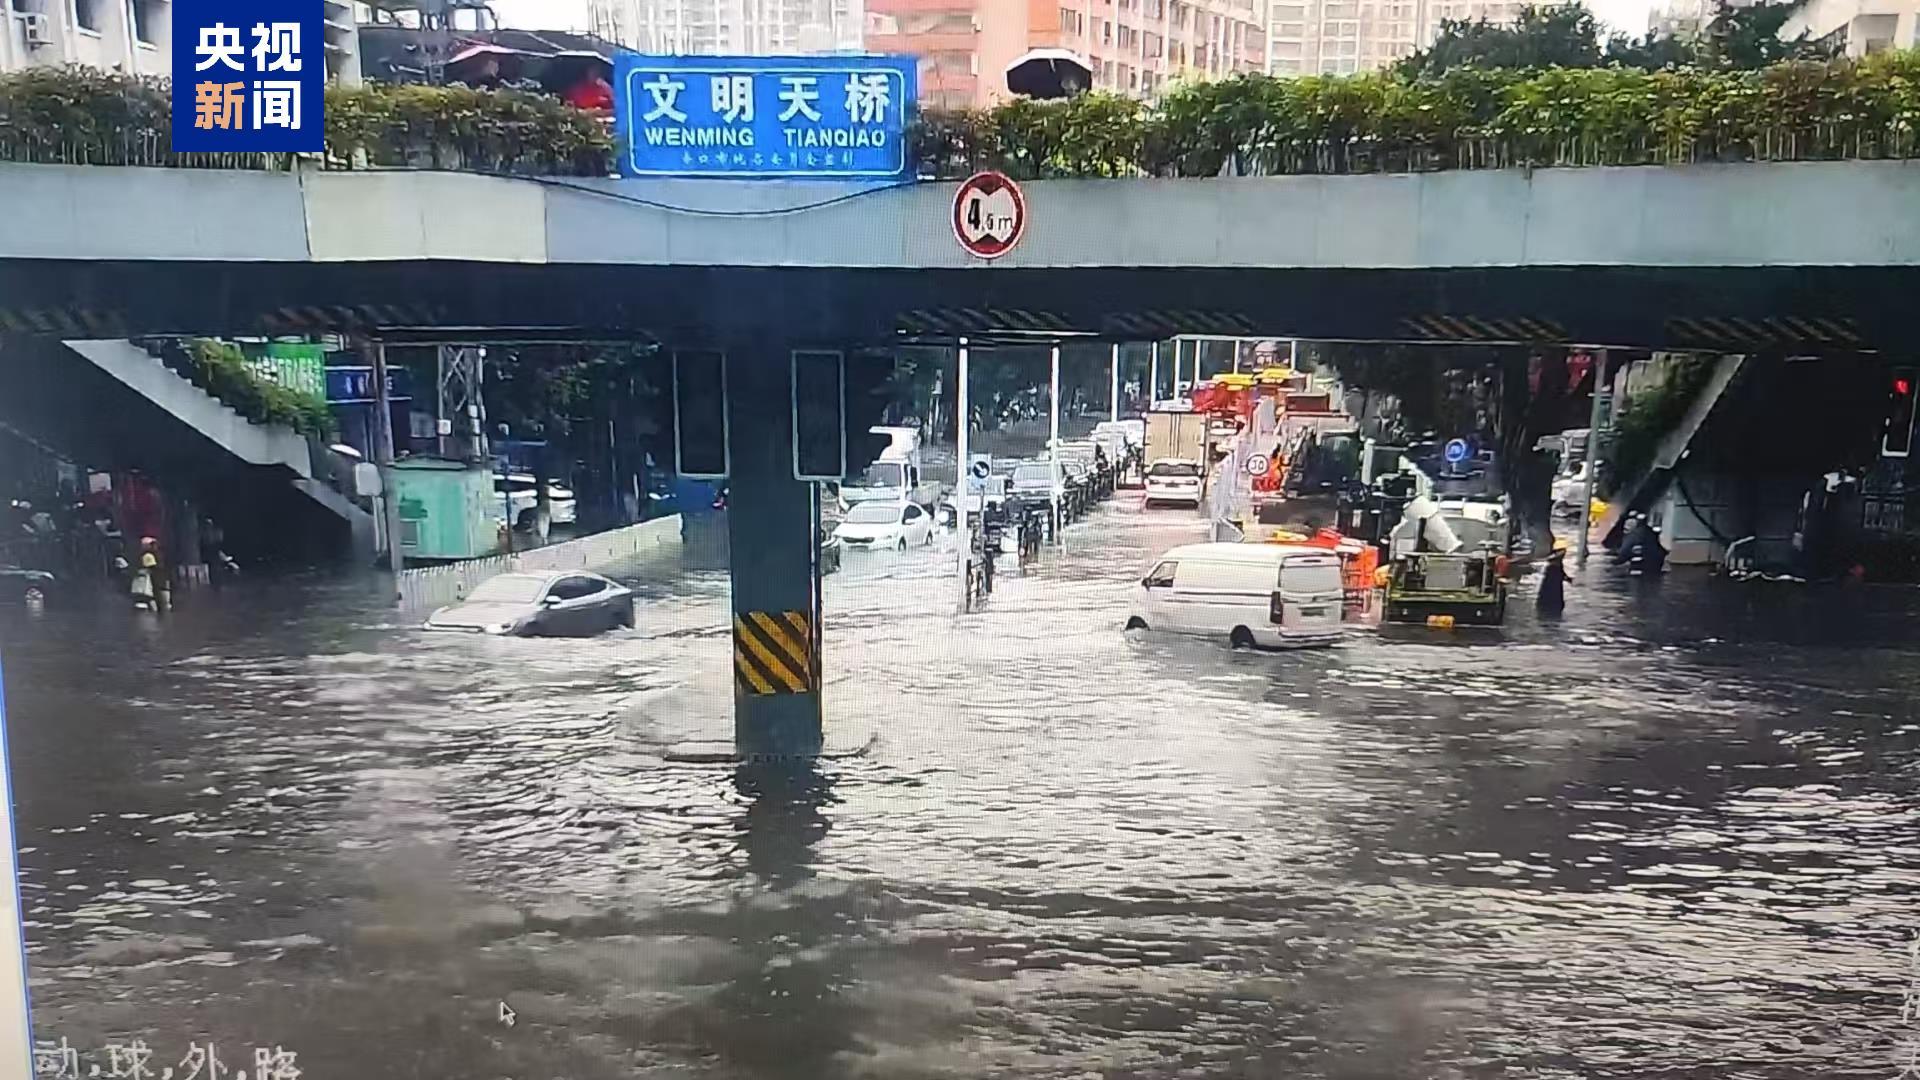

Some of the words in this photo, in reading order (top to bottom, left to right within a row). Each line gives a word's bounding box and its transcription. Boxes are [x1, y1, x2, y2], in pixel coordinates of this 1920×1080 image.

[642, 73, 890, 123] 文明天桥
[645, 128, 754, 147] WENMING
[783, 128, 886, 148] TIANQIAO
